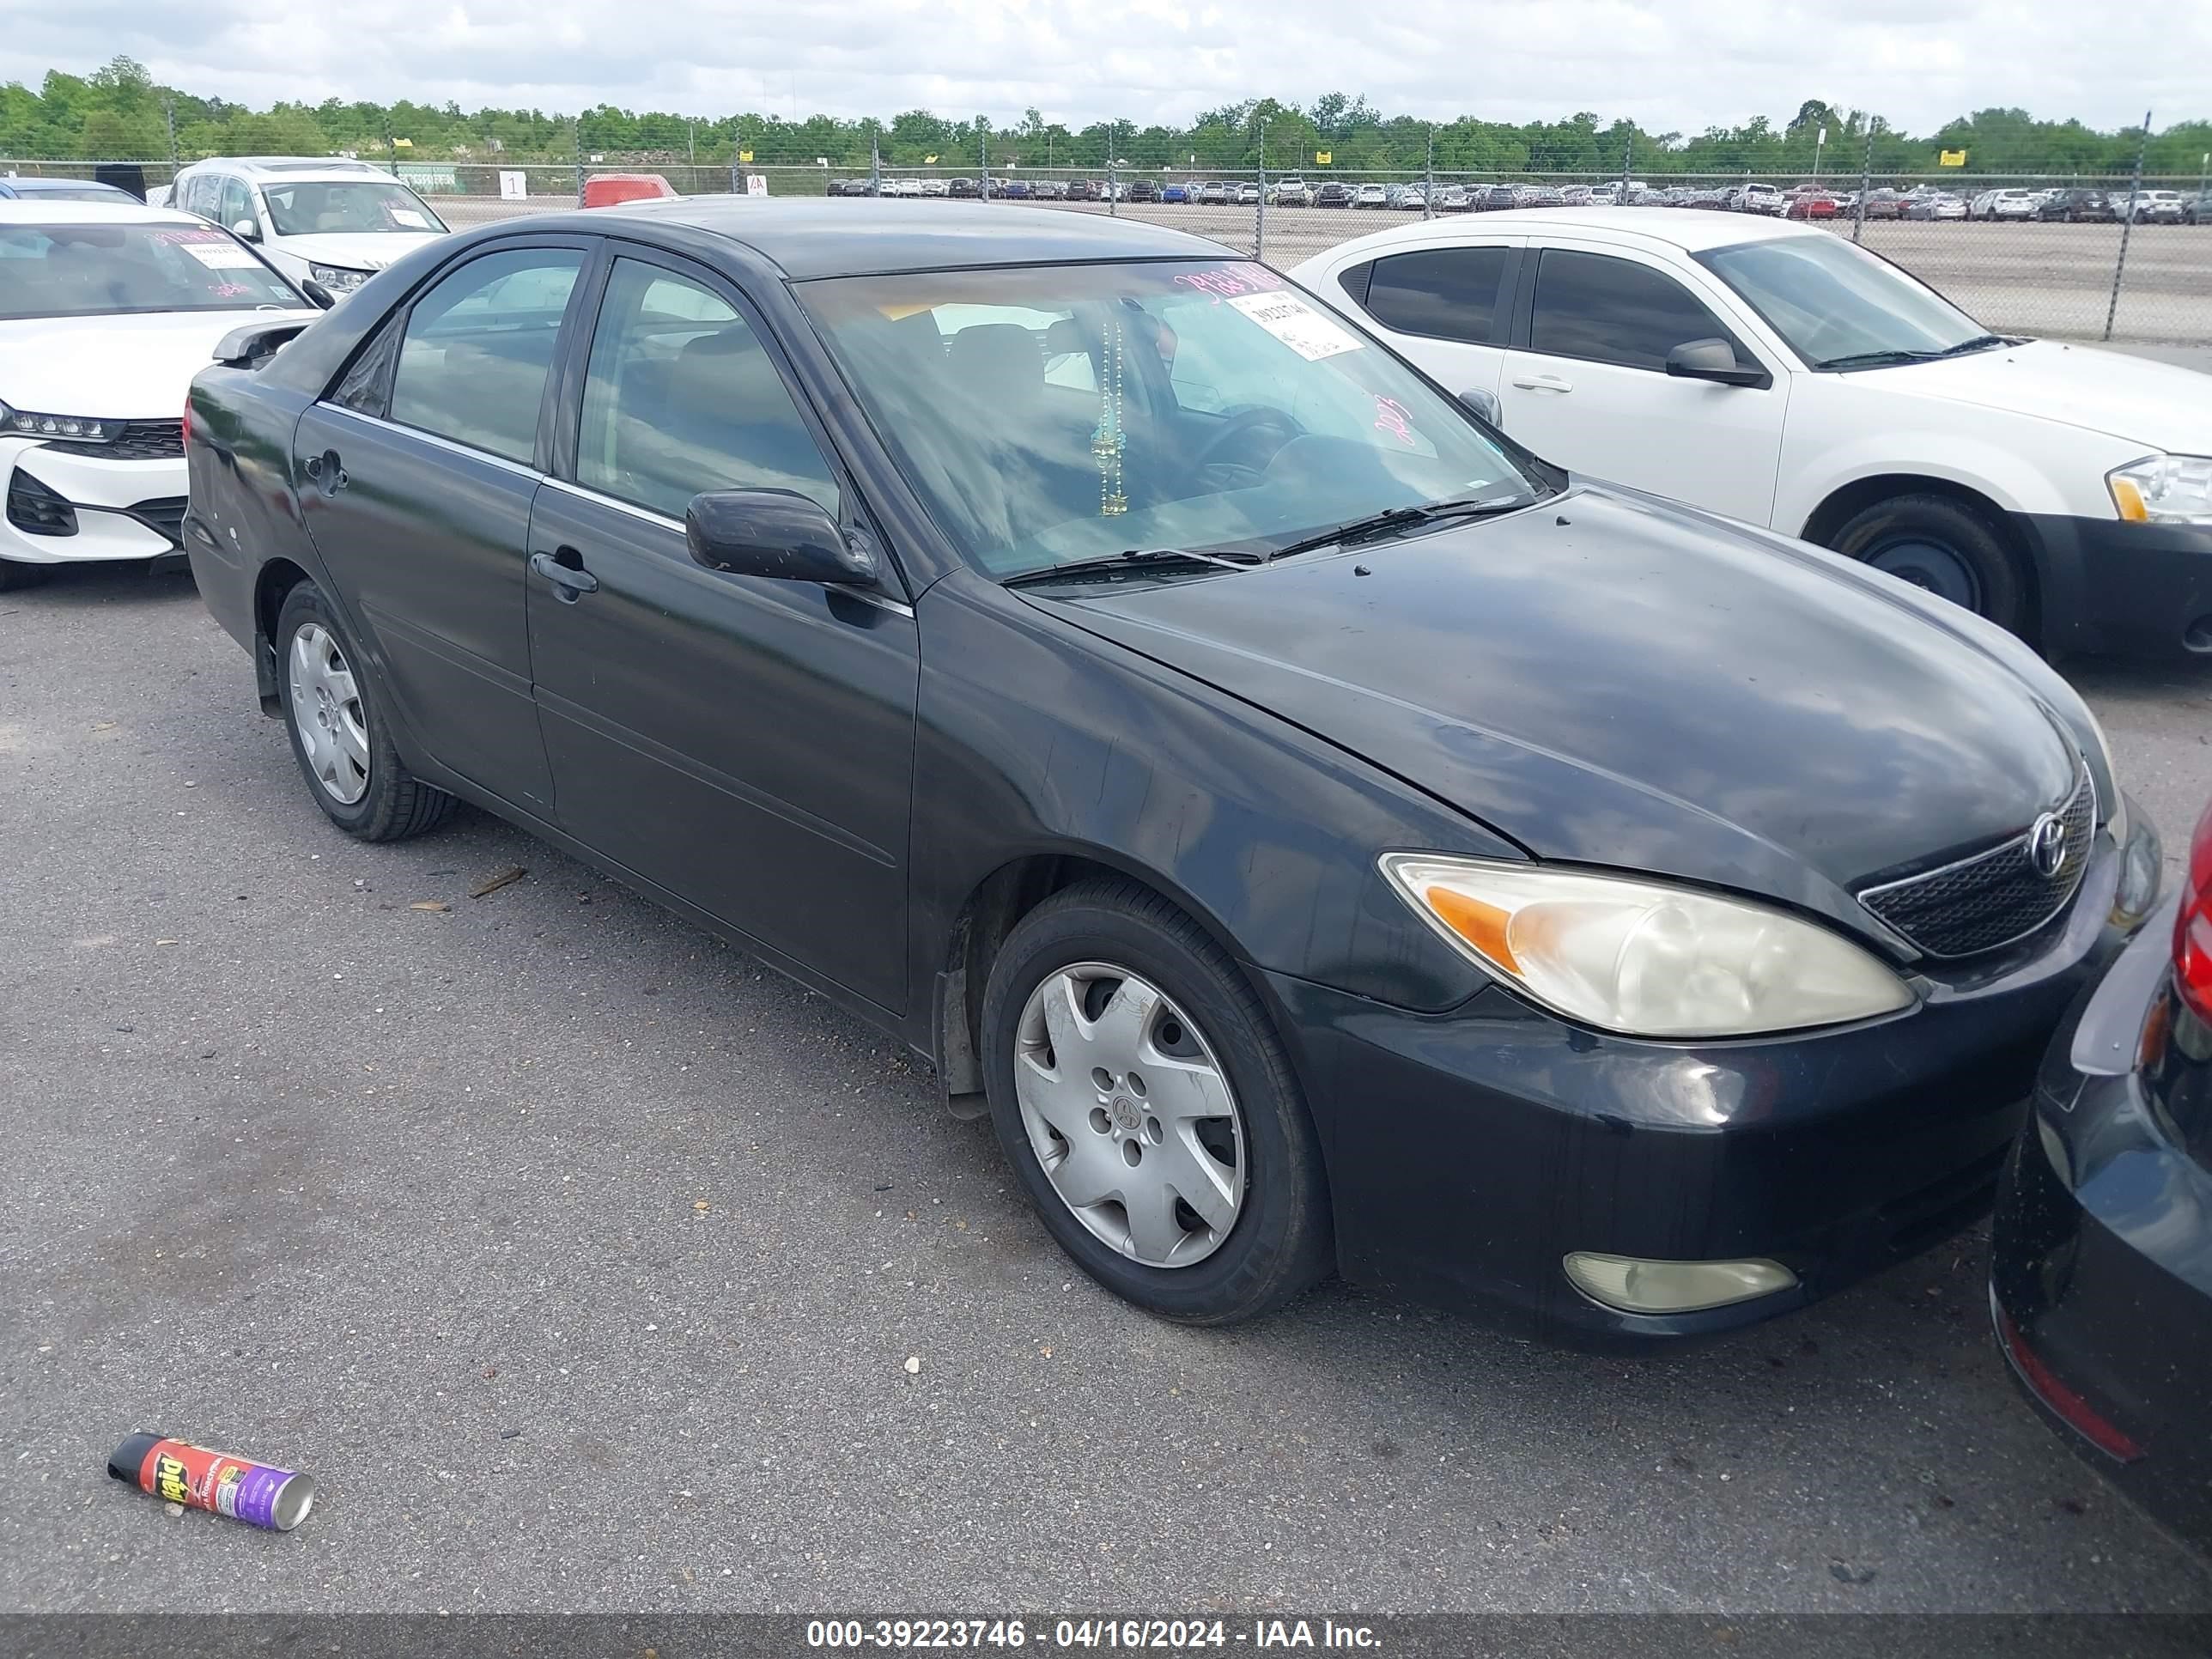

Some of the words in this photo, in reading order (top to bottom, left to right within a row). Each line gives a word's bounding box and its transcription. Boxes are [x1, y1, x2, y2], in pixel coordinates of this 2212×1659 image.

[508, 177, 519, 195] 1
[1252, 302, 1310, 324] 39223746
[158, 1457, 187, 1502] Raid
